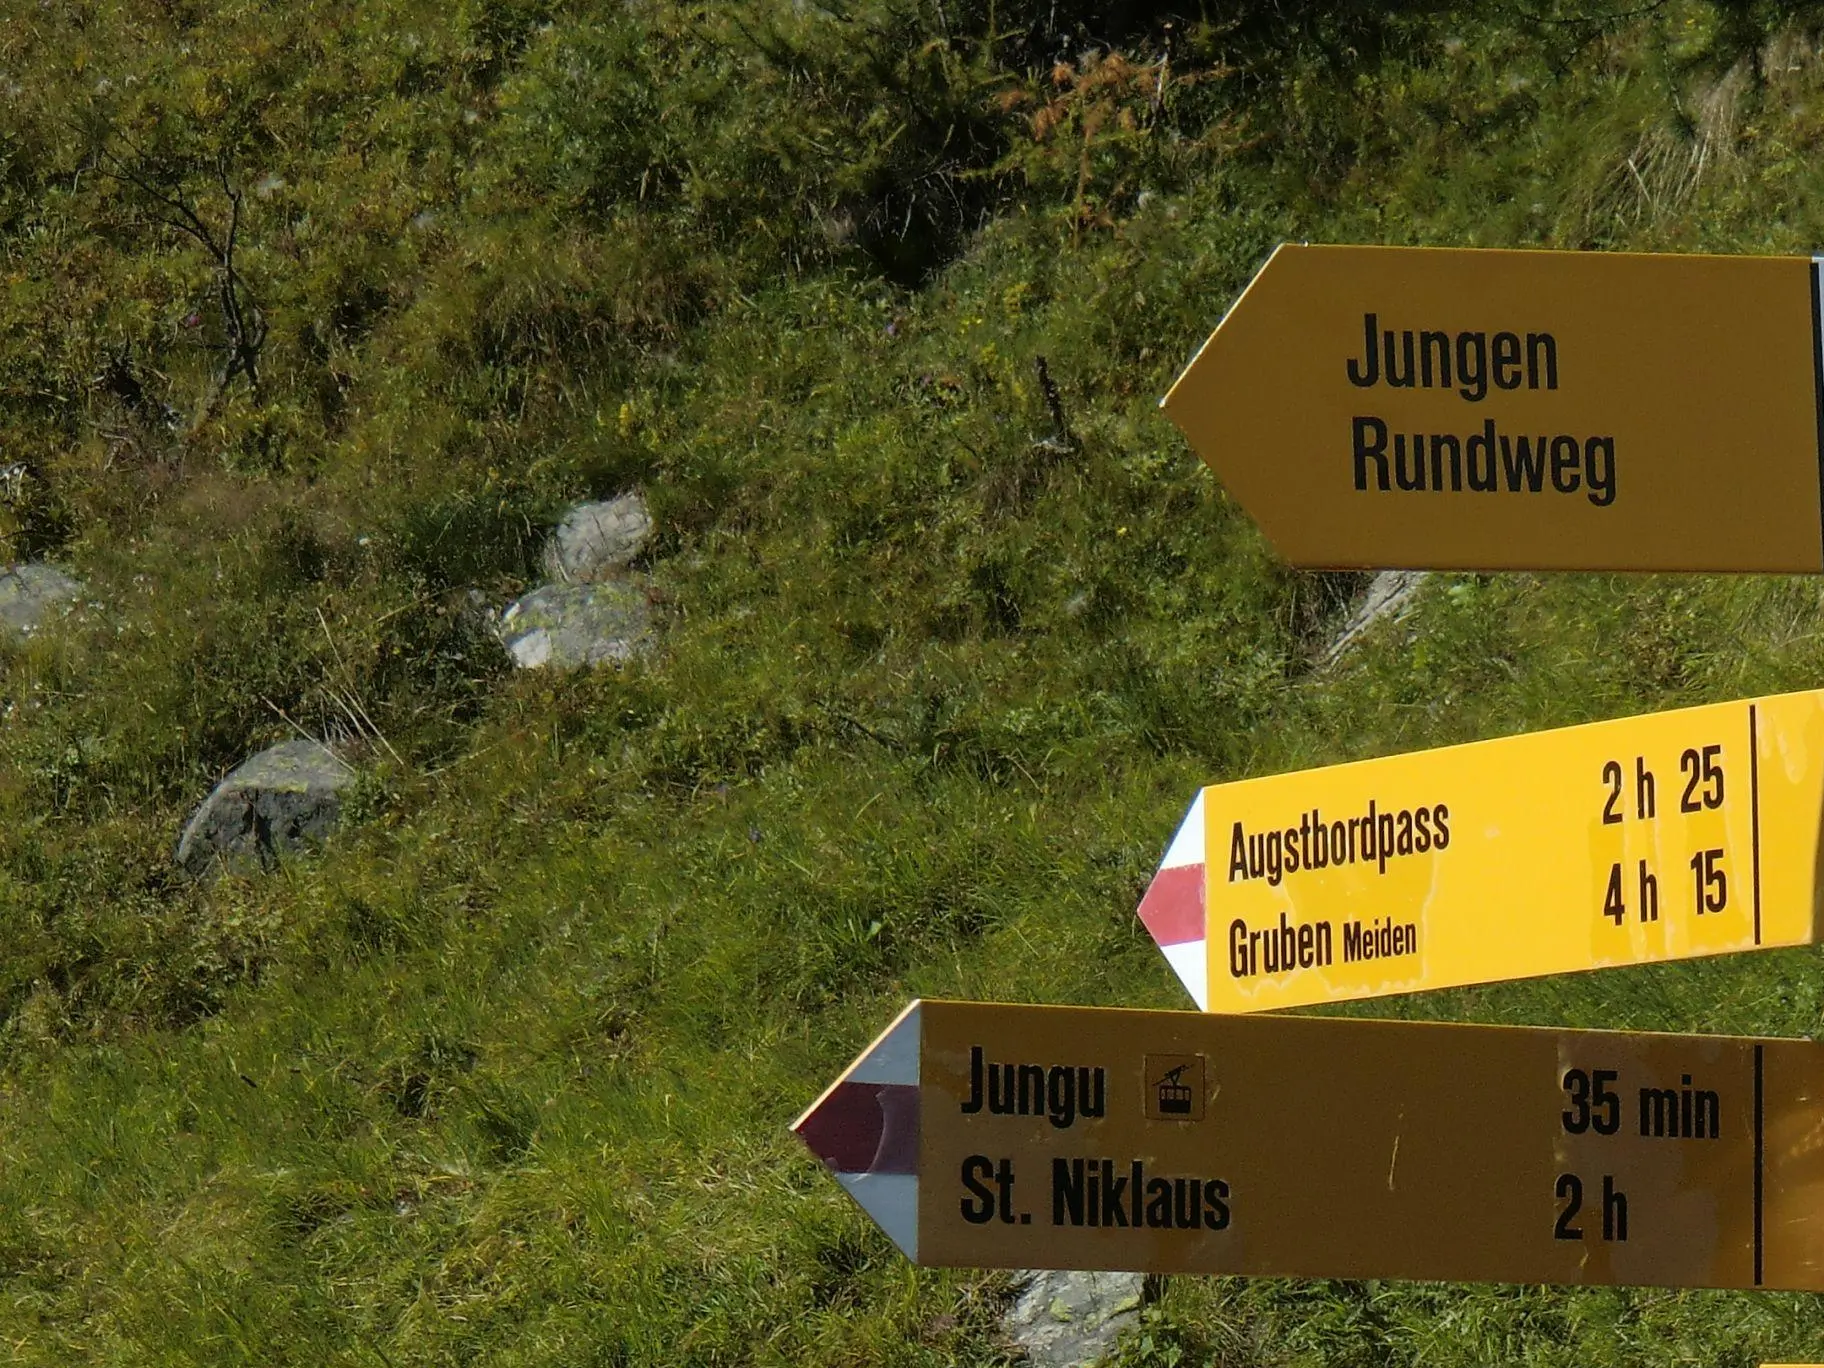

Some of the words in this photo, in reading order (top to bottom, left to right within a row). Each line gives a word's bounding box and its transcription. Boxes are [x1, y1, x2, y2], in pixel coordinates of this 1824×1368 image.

[1347, 312, 1558, 402] Jungen
[1352, 416, 1617, 507] Rundweg
[1228, 799, 1450, 885] Augstbordpass
[1602, 760, 1624, 825] 2
[1638, 756, 1656, 818] h
[1680, 744, 1725, 813] 25
[1229, 913, 1332, 979] Gruben
[1343, 917, 1417, 964] Meiden
[1604, 862, 1625, 926] 4
[1639, 859, 1658, 921] h
[1691, 848, 1727, 915] 15
[961, 1046, 1105, 1129] Jungu
[1562, 1069, 1621, 1136] 35
[1640, 1074, 1719, 1140] min
[960, 1155, 1031, 1226] St.
[1053, 1157, 1231, 1231] Niklaus
[1554, 1173, 1583, 1240] 2
[1603, 1175, 1627, 1242] h
